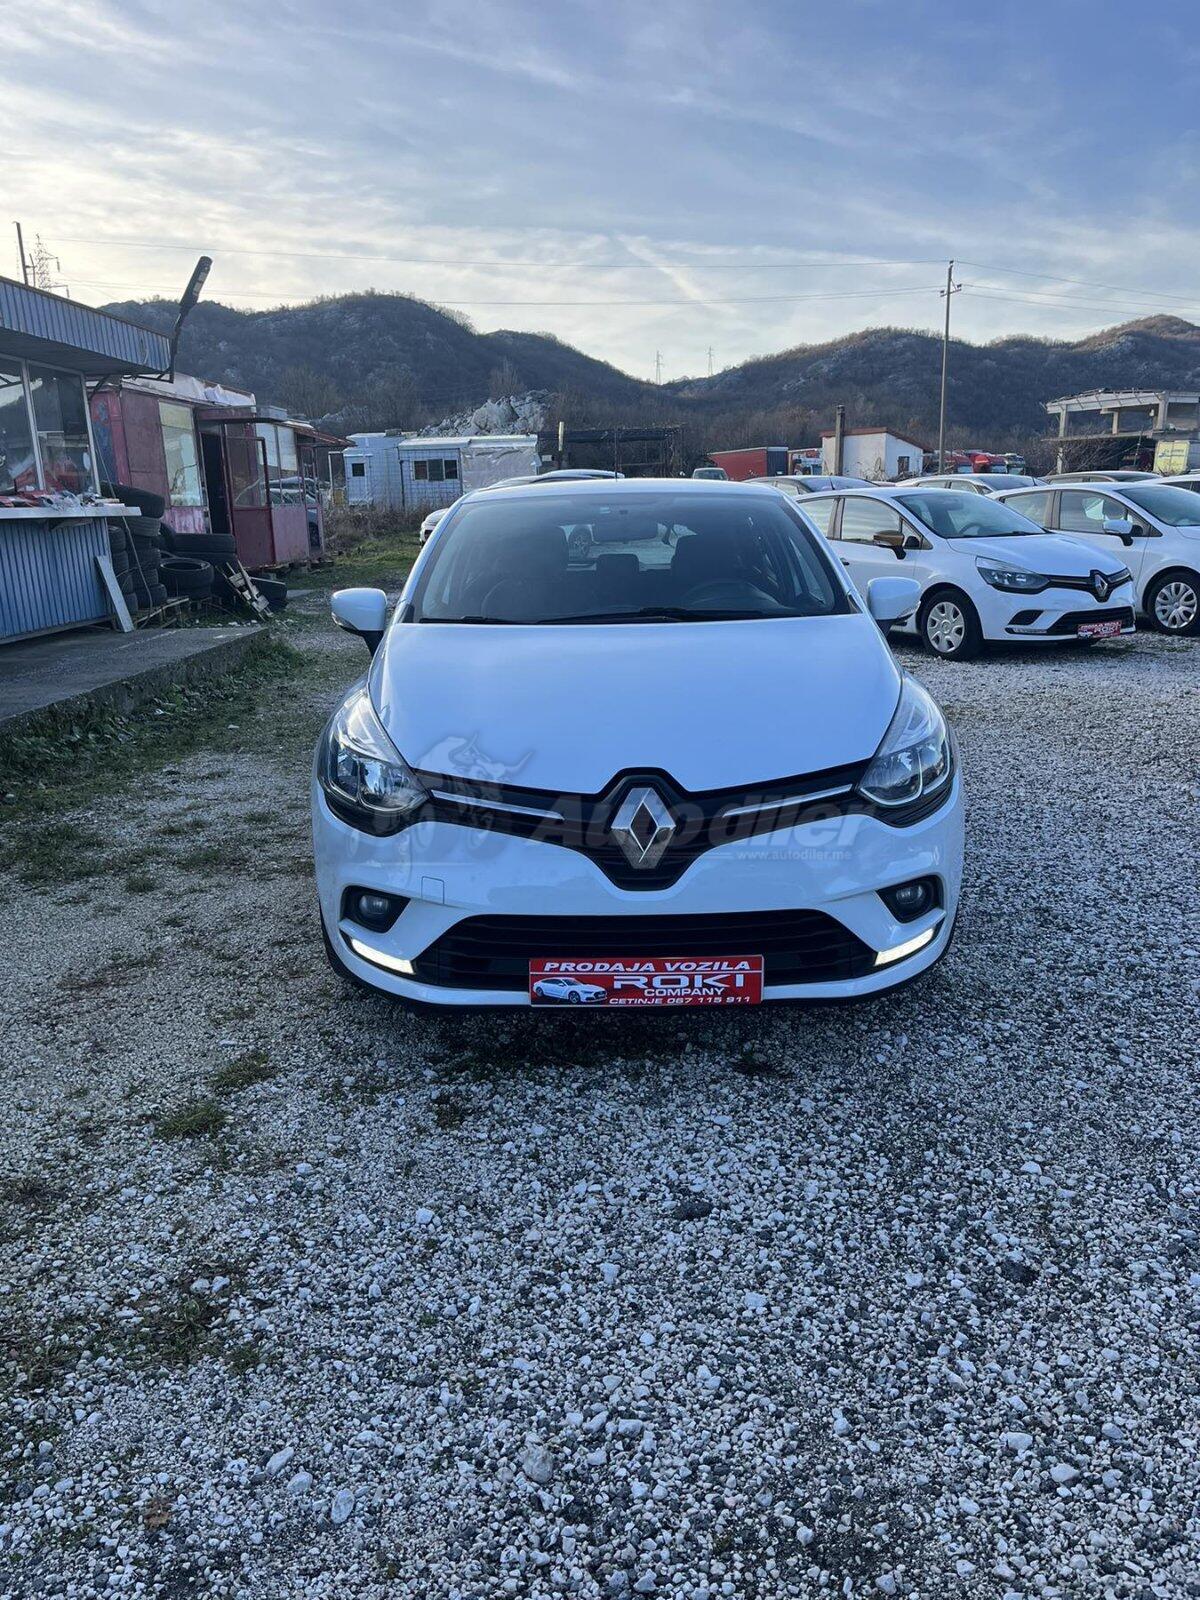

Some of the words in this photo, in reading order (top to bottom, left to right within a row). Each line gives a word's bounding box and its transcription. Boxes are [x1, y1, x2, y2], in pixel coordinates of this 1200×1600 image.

[543, 961, 656, 972] PRODAJA
[665, 961, 751, 972] VOZILA
[613, 974, 744, 989] ROKI
[644, 988, 725, 996] COMPANY
